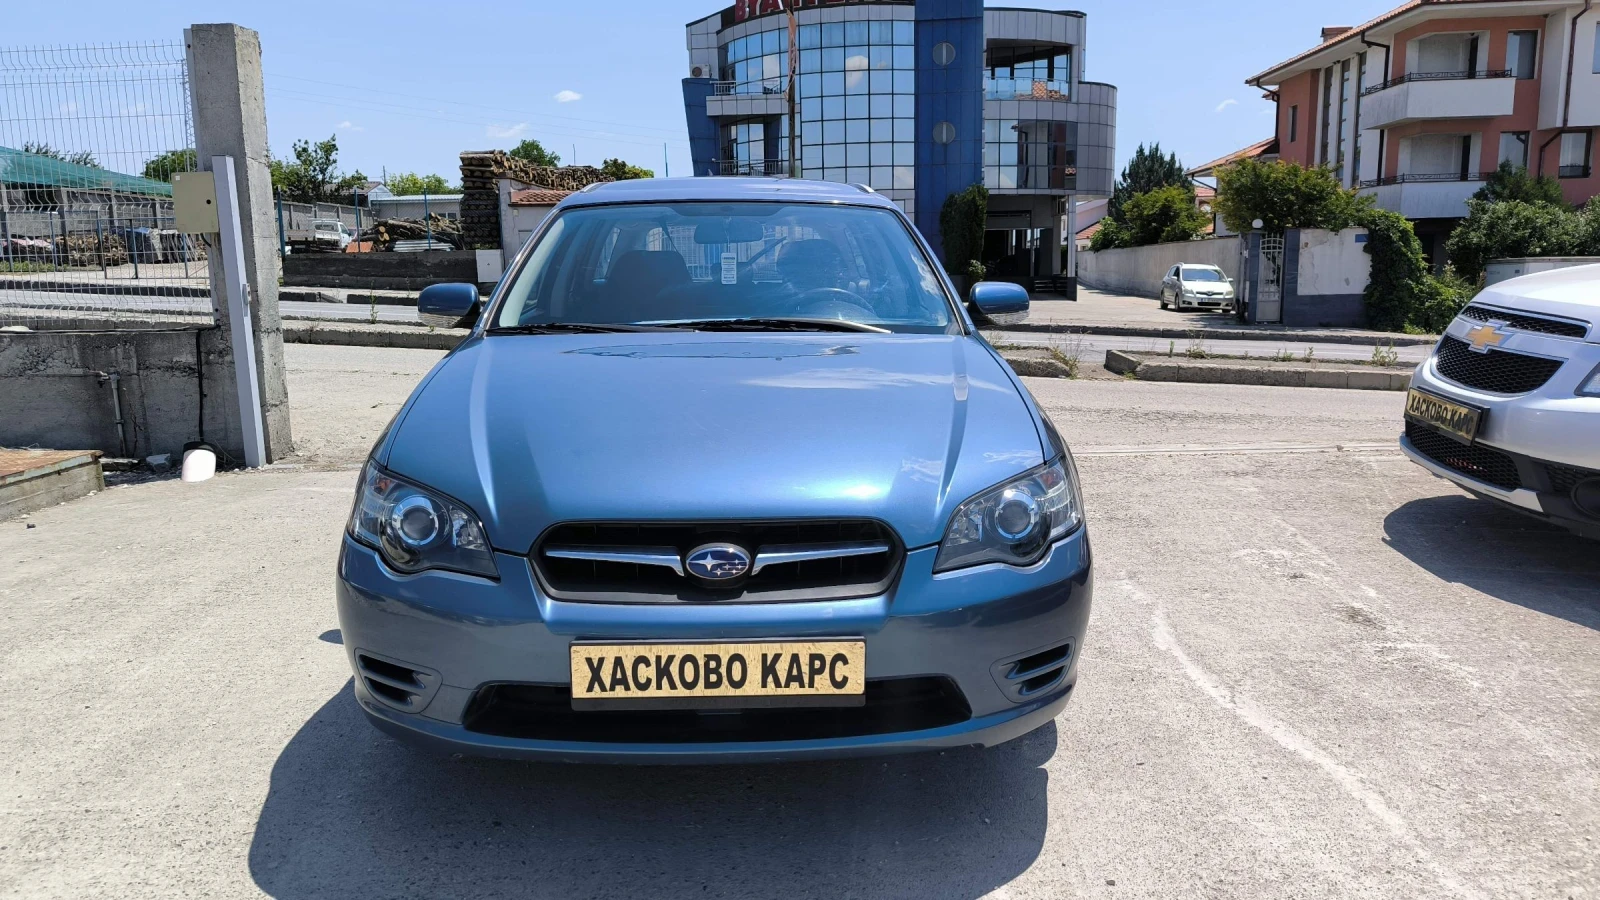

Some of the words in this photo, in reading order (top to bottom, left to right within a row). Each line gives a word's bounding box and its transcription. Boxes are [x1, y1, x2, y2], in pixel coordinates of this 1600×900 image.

[1409, 394, 1449, 425] ХАСКОВО
[1448, 407, 1474, 435] КАРС
[585, 653, 748, 693] ХАСКОВО
[760, 652, 850, 690] КАРС
